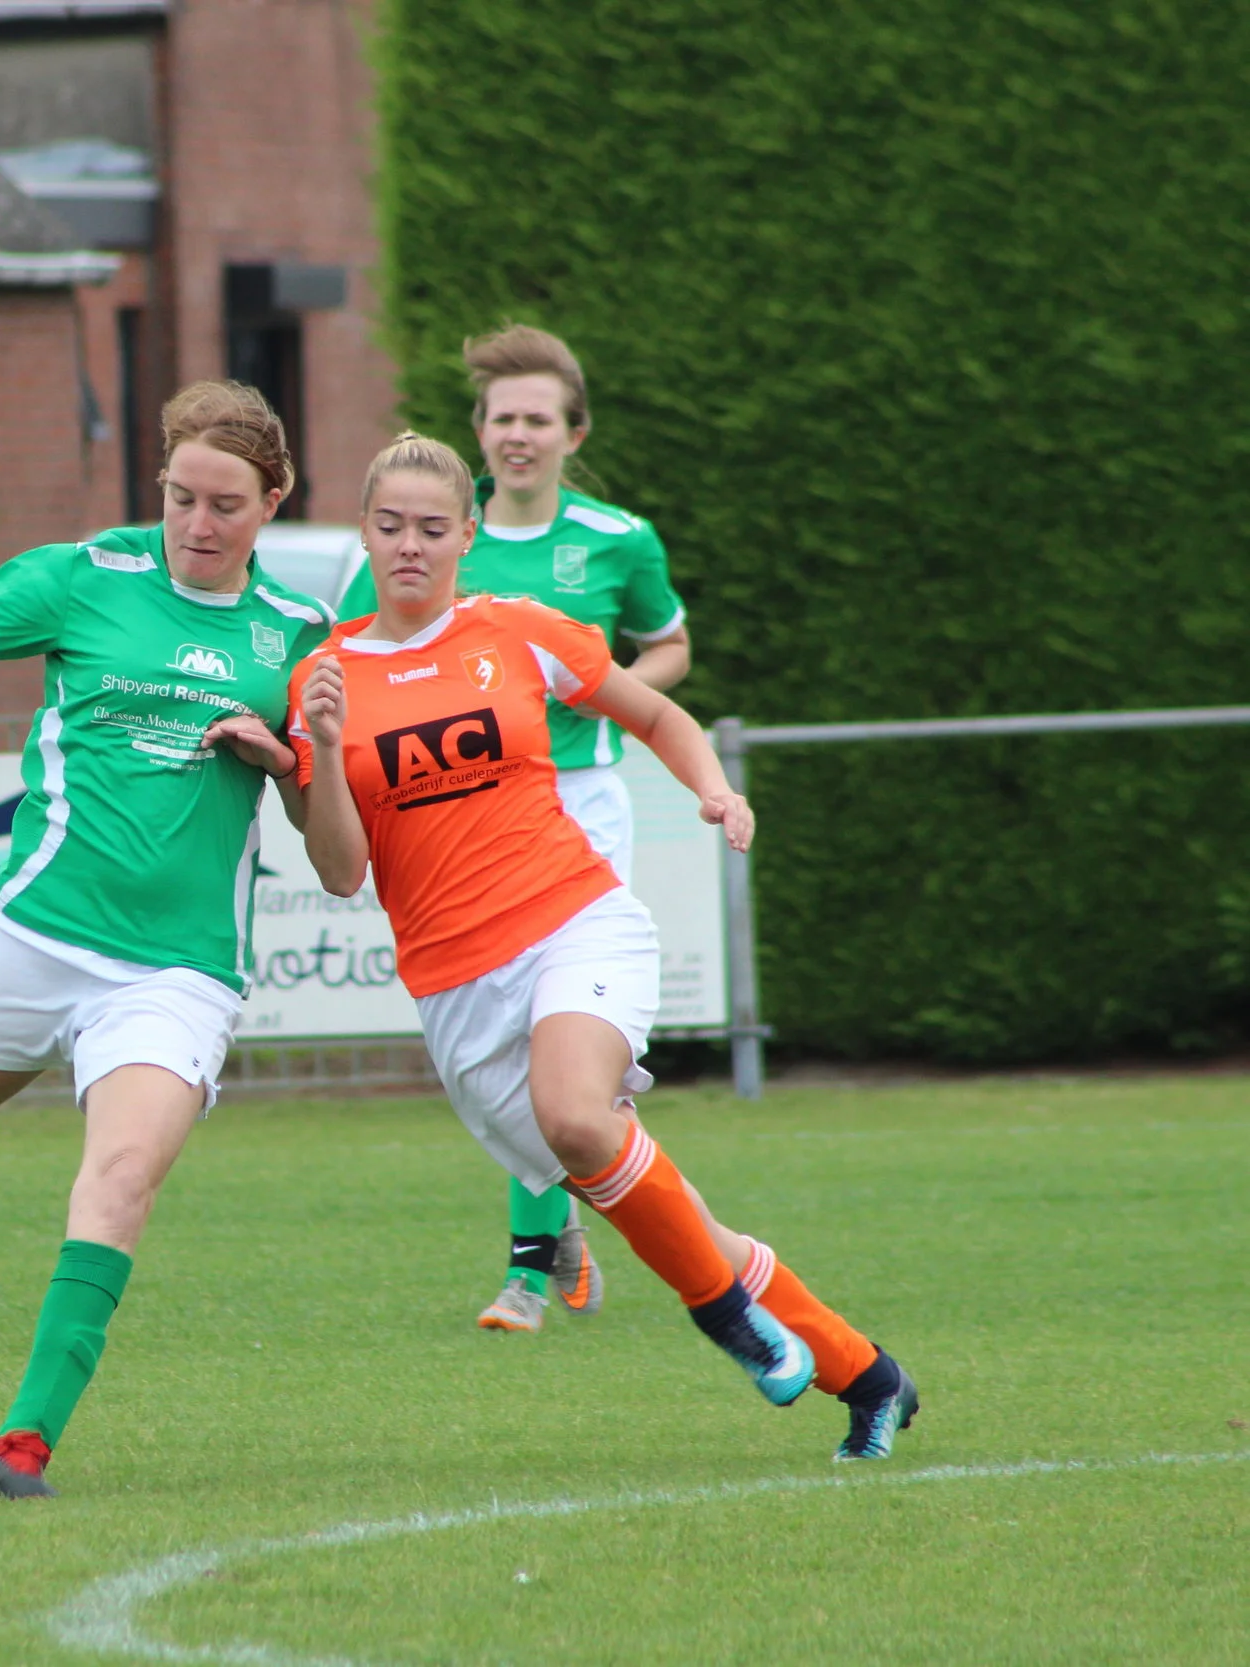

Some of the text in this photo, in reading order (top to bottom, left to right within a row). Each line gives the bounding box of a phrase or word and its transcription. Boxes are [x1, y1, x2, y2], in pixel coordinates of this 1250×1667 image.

[101, 673, 170, 698] Shipyard
[388, 662, 439, 685] hummel
[396, 719, 490, 786] AC
[373, 762, 522, 809] autobedrijf cuelenaere
